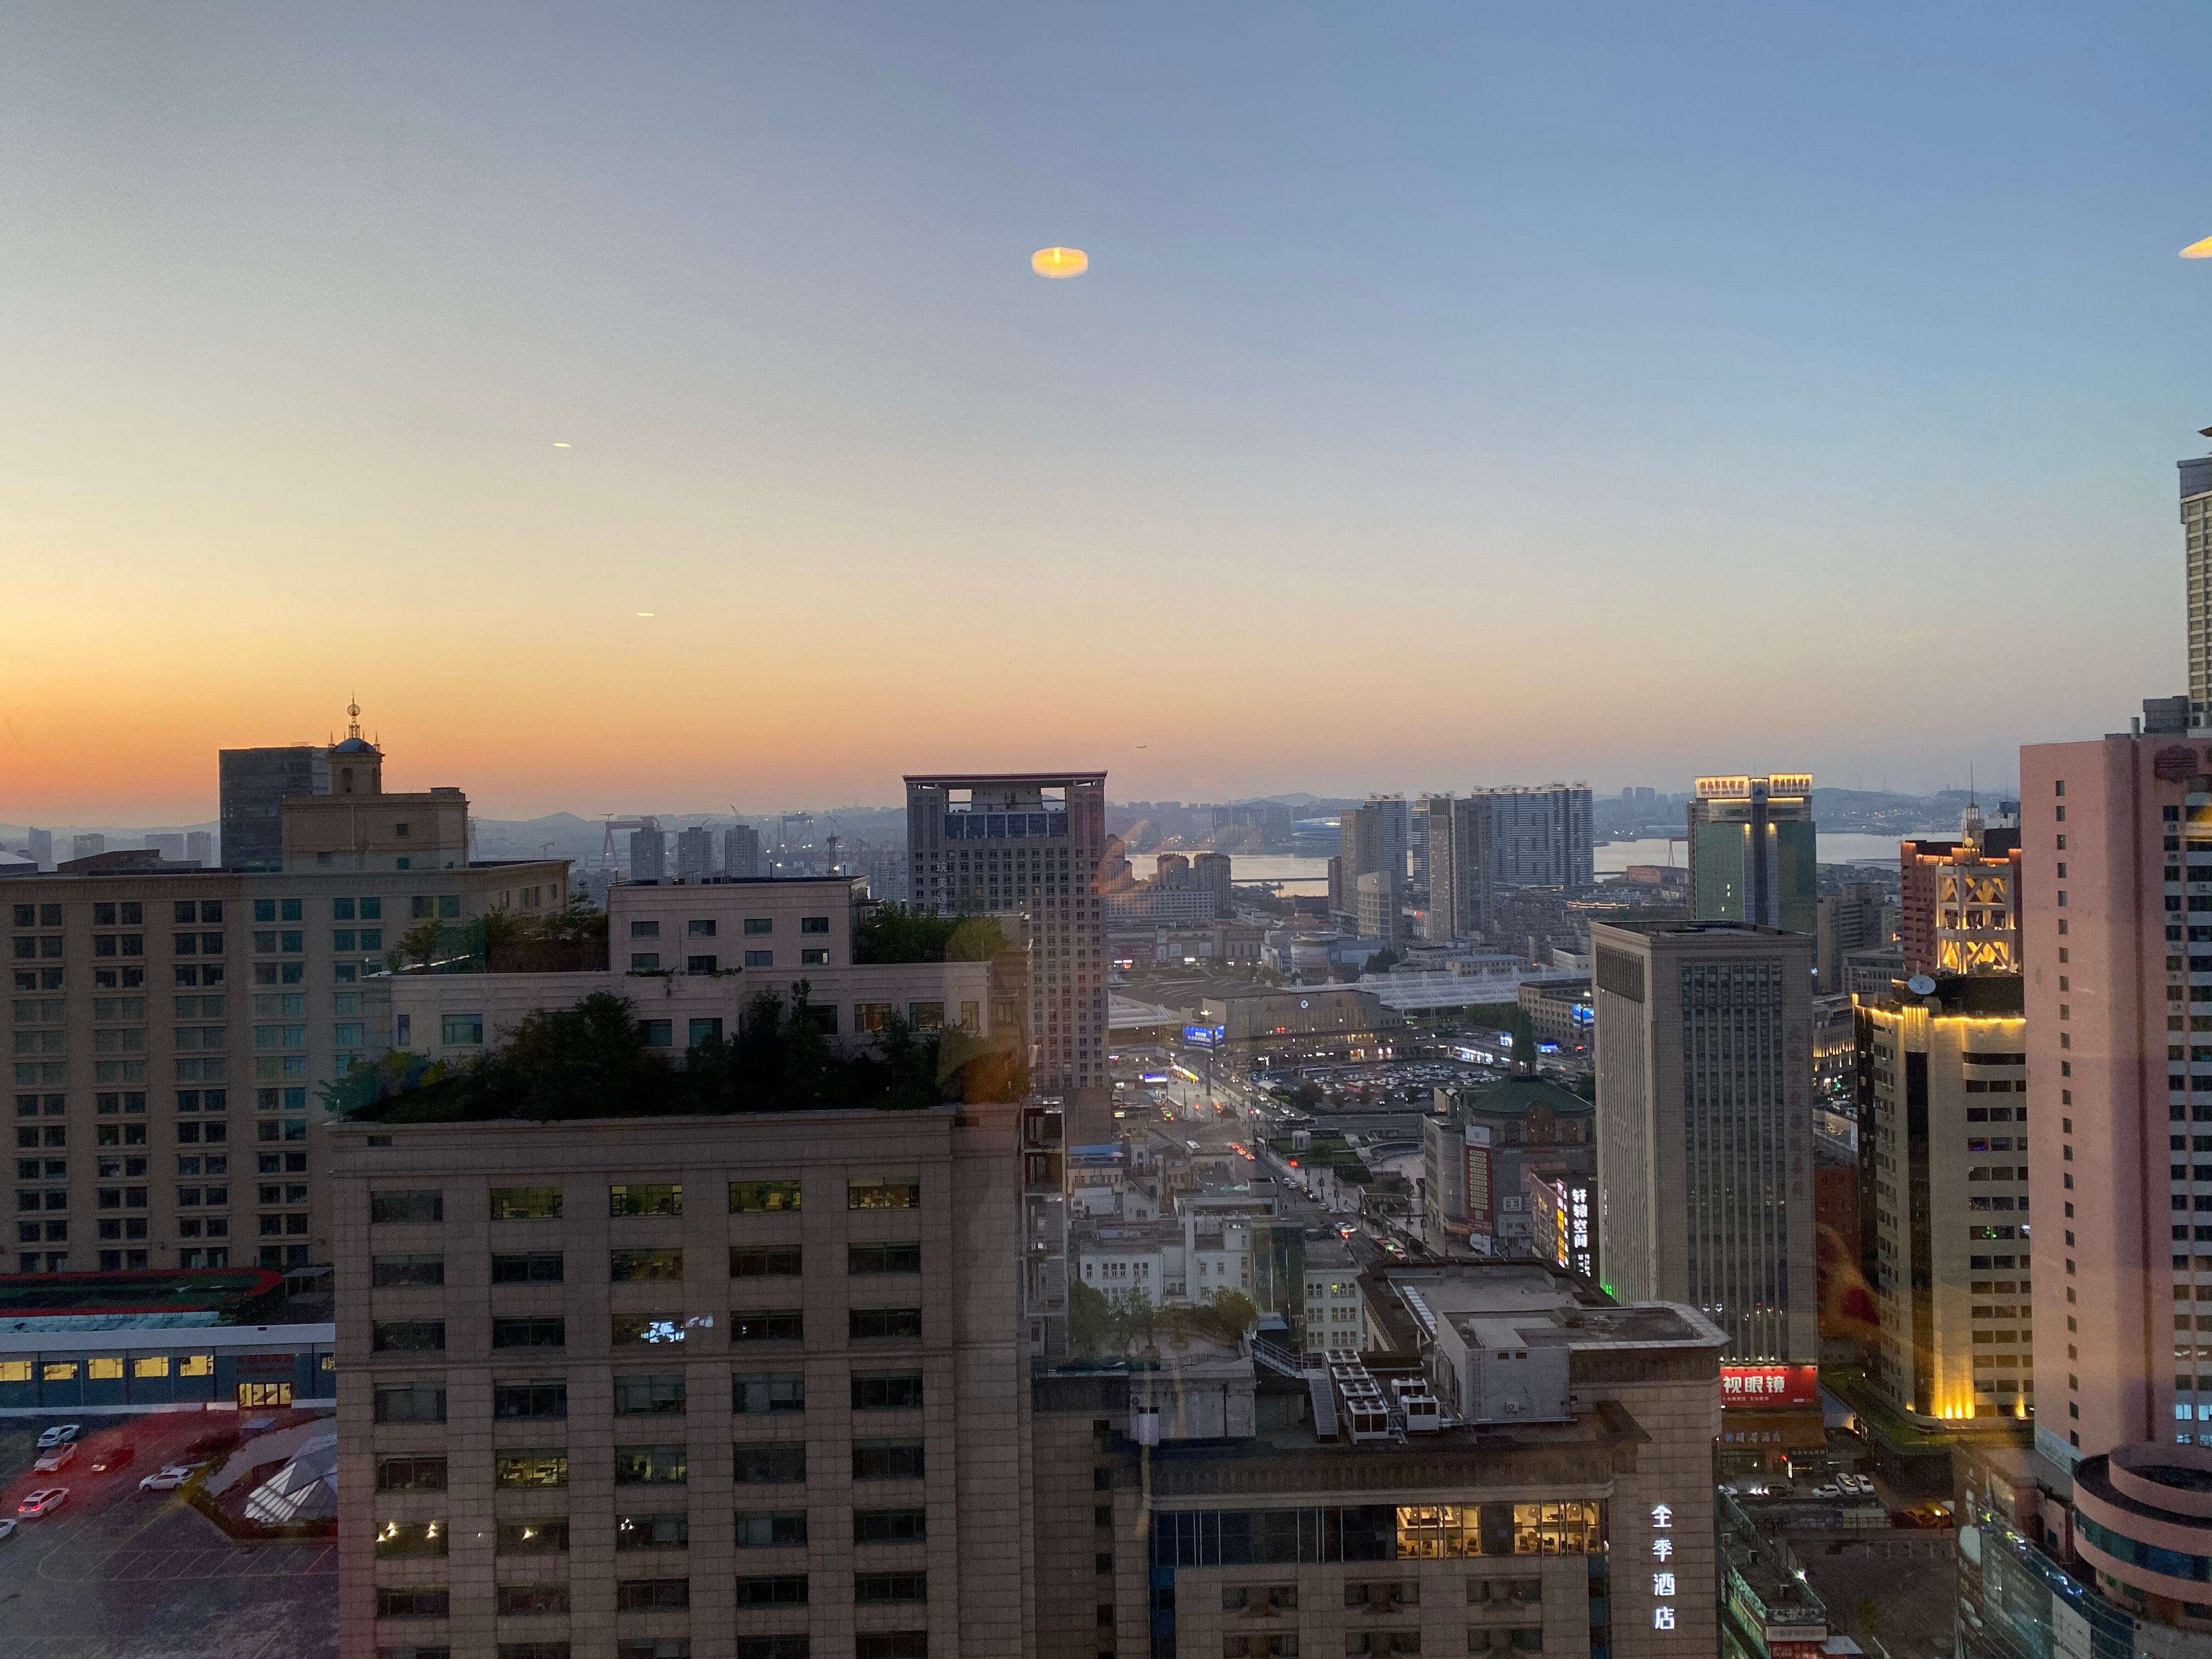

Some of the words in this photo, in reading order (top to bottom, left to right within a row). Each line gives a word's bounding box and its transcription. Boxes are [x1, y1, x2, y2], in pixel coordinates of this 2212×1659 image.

[1572, 1188, 1588, 1248] 轩辕空间
[1723, 1375, 1785, 1394] 视眼镜
[1651, 1504, 1676, 1630] 全季酒店
